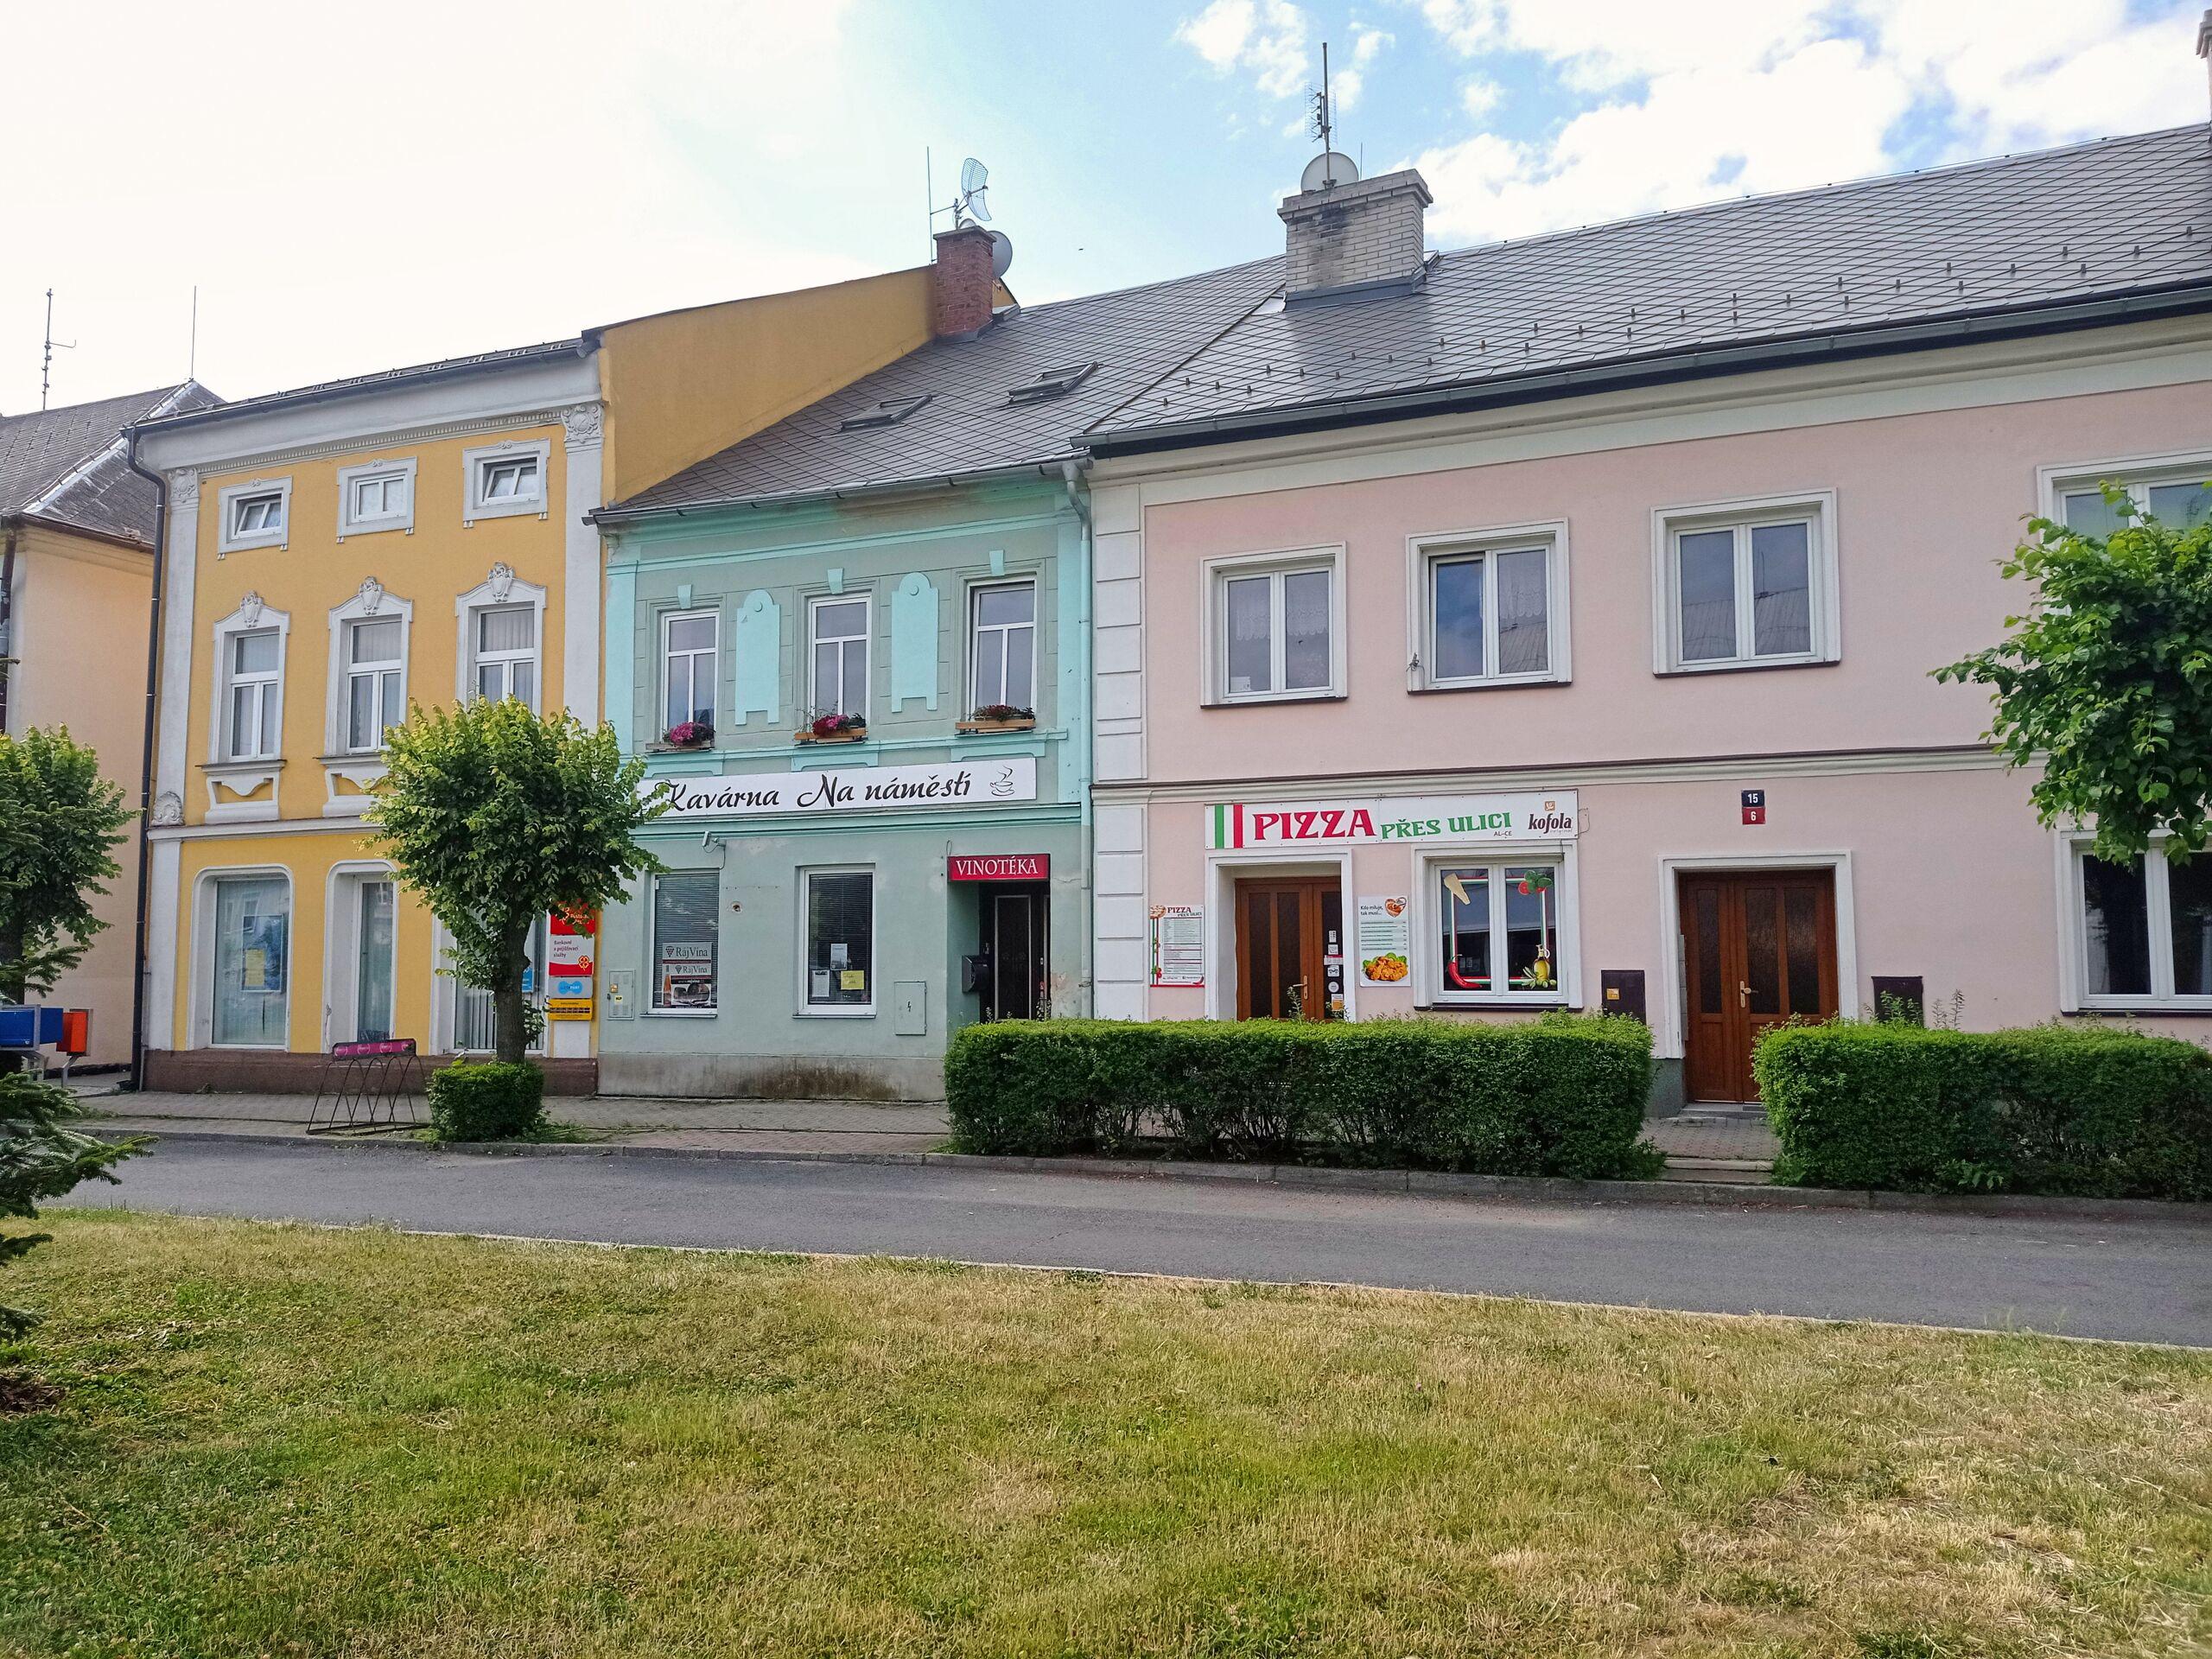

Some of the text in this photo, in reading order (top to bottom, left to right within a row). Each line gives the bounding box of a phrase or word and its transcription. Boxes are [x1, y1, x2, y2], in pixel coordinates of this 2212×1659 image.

[654, 771, 971, 811] Kavárna Na náměstí
[1747, 793, 1758, 804] 15
[1252, 809, 1512, 841] PIZZA PŘES ULICI
[1528, 812, 1573, 835] kofola
[1751, 810, 1757, 822] 6
[956, 855, 1039, 875] VINOTÉKA
